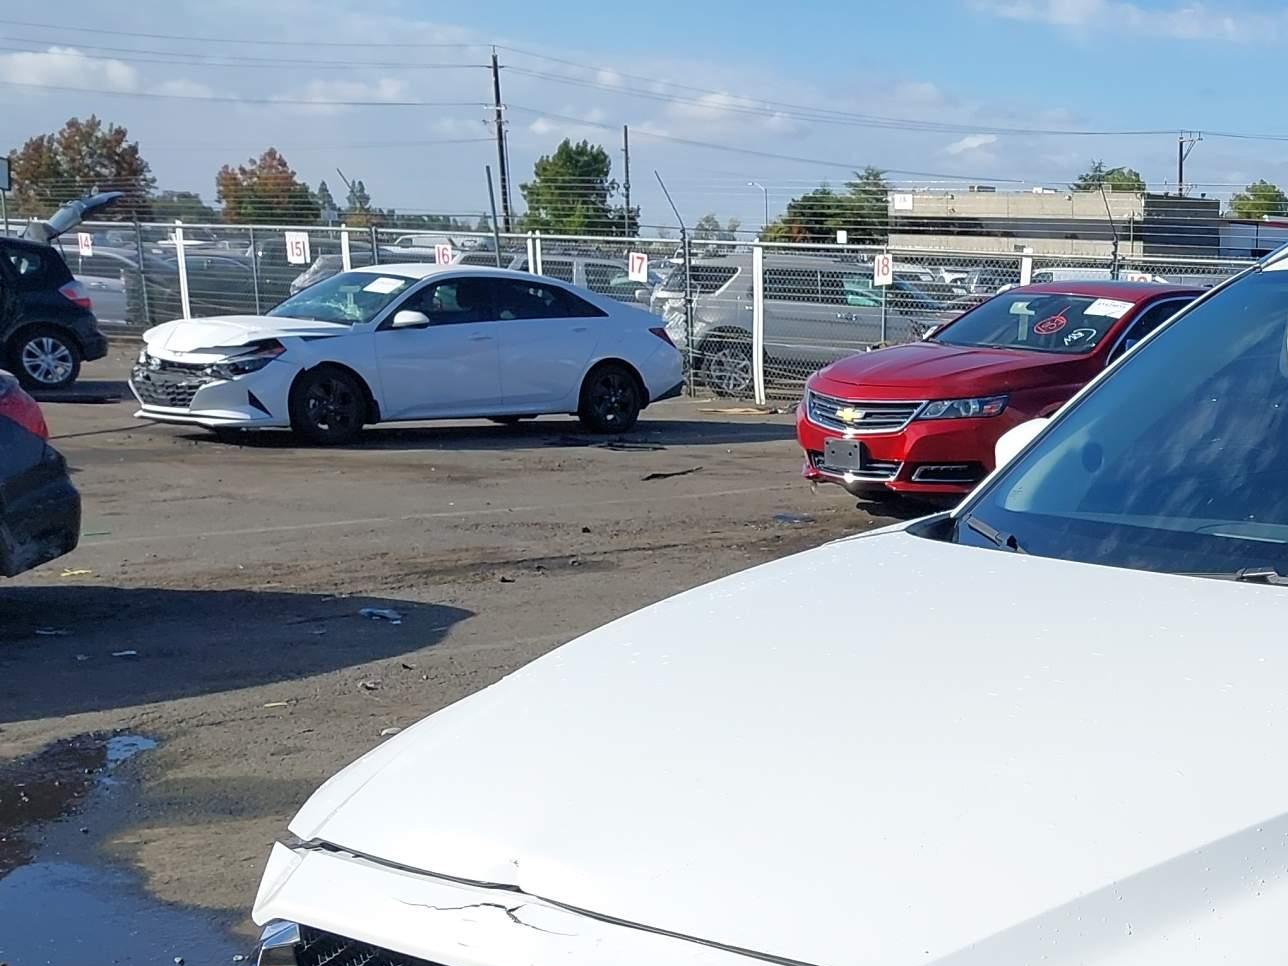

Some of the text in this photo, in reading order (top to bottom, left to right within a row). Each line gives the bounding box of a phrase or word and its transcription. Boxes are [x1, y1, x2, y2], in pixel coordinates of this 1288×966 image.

[79, 234, 90, 250] 14
[290, 241, 303, 257] 15
[437, 247, 450, 264] 16
[631, 255, 645, 274] 17
[876, 255, 890, 277] 18
